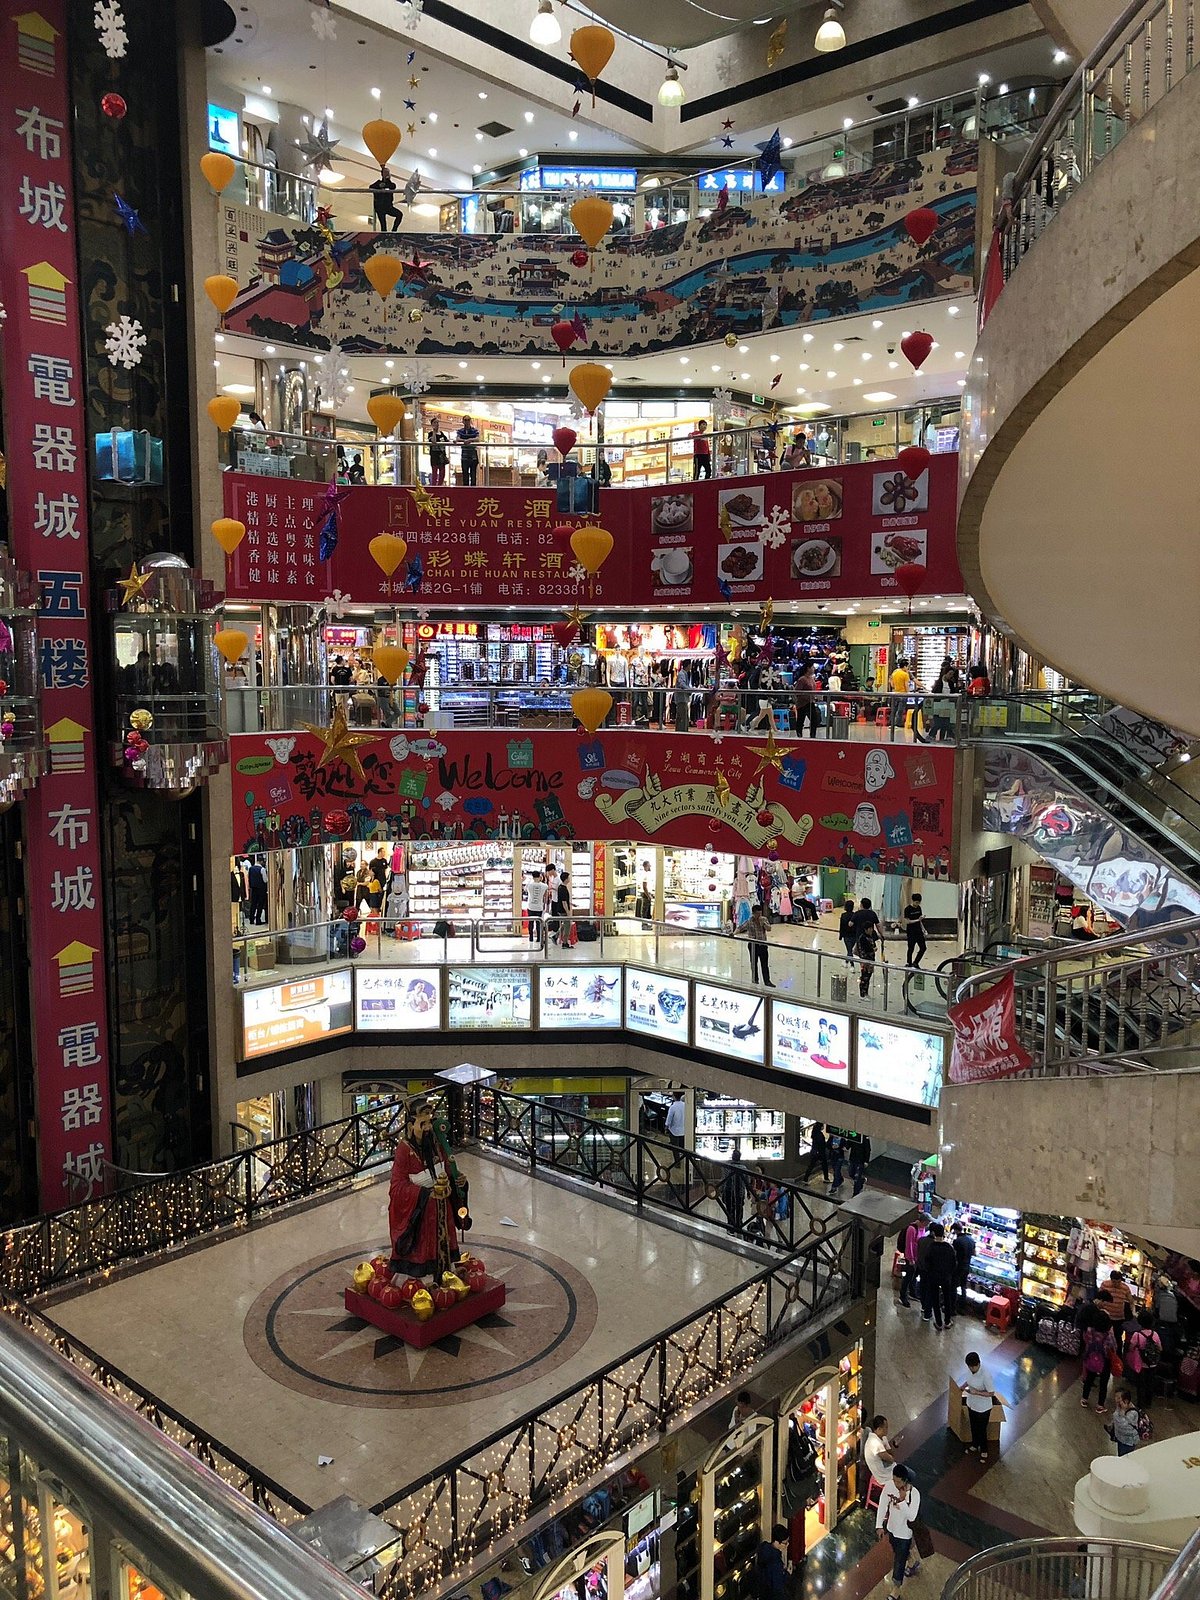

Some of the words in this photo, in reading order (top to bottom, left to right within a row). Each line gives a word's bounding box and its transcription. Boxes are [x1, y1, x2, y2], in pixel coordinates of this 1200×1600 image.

[15, 104, 69, 233] 布城
[28, 353, 81, 540] 電器城
[246, 490, 314, 513] 港厨主理
[430, 497, 602, 520] 梨苑酒
[247, 510, 315, 530] 精美点心
[426, 518, 451, 527] LEE
[460, 519, 498, 528] YUAN
[247, 529, 315, 549] 精选粤菜
[248, 548, 315, 568] 香辣风味
[426, 550, 583, 569] 彩蝶轩酒
[248, 566, 316, 586] 健康素食
[426, 569, 455, 578] CHAI
[460, 570, 479, 578] DIE
[485, 570, 518, 578] HUAN
[36, 570, 90, 689] 五楼
[664, 749, 743, 768] 罗湖商业城
[438, 751, 564, 793] Welcome
[727, 767, 743, 780] City
[654, 809, 669, 825] Nine
[670, 804, 695, 815] sectors
[697, 804, 721, 816] satisfy
[722, 812, 736, 824] you
[736, 821, 749, 832] all
[705, 790, 755, 824] 應盡有
[48, 803, 96, 914] 布城
[57, 1020, 106, 1194] 電器城
